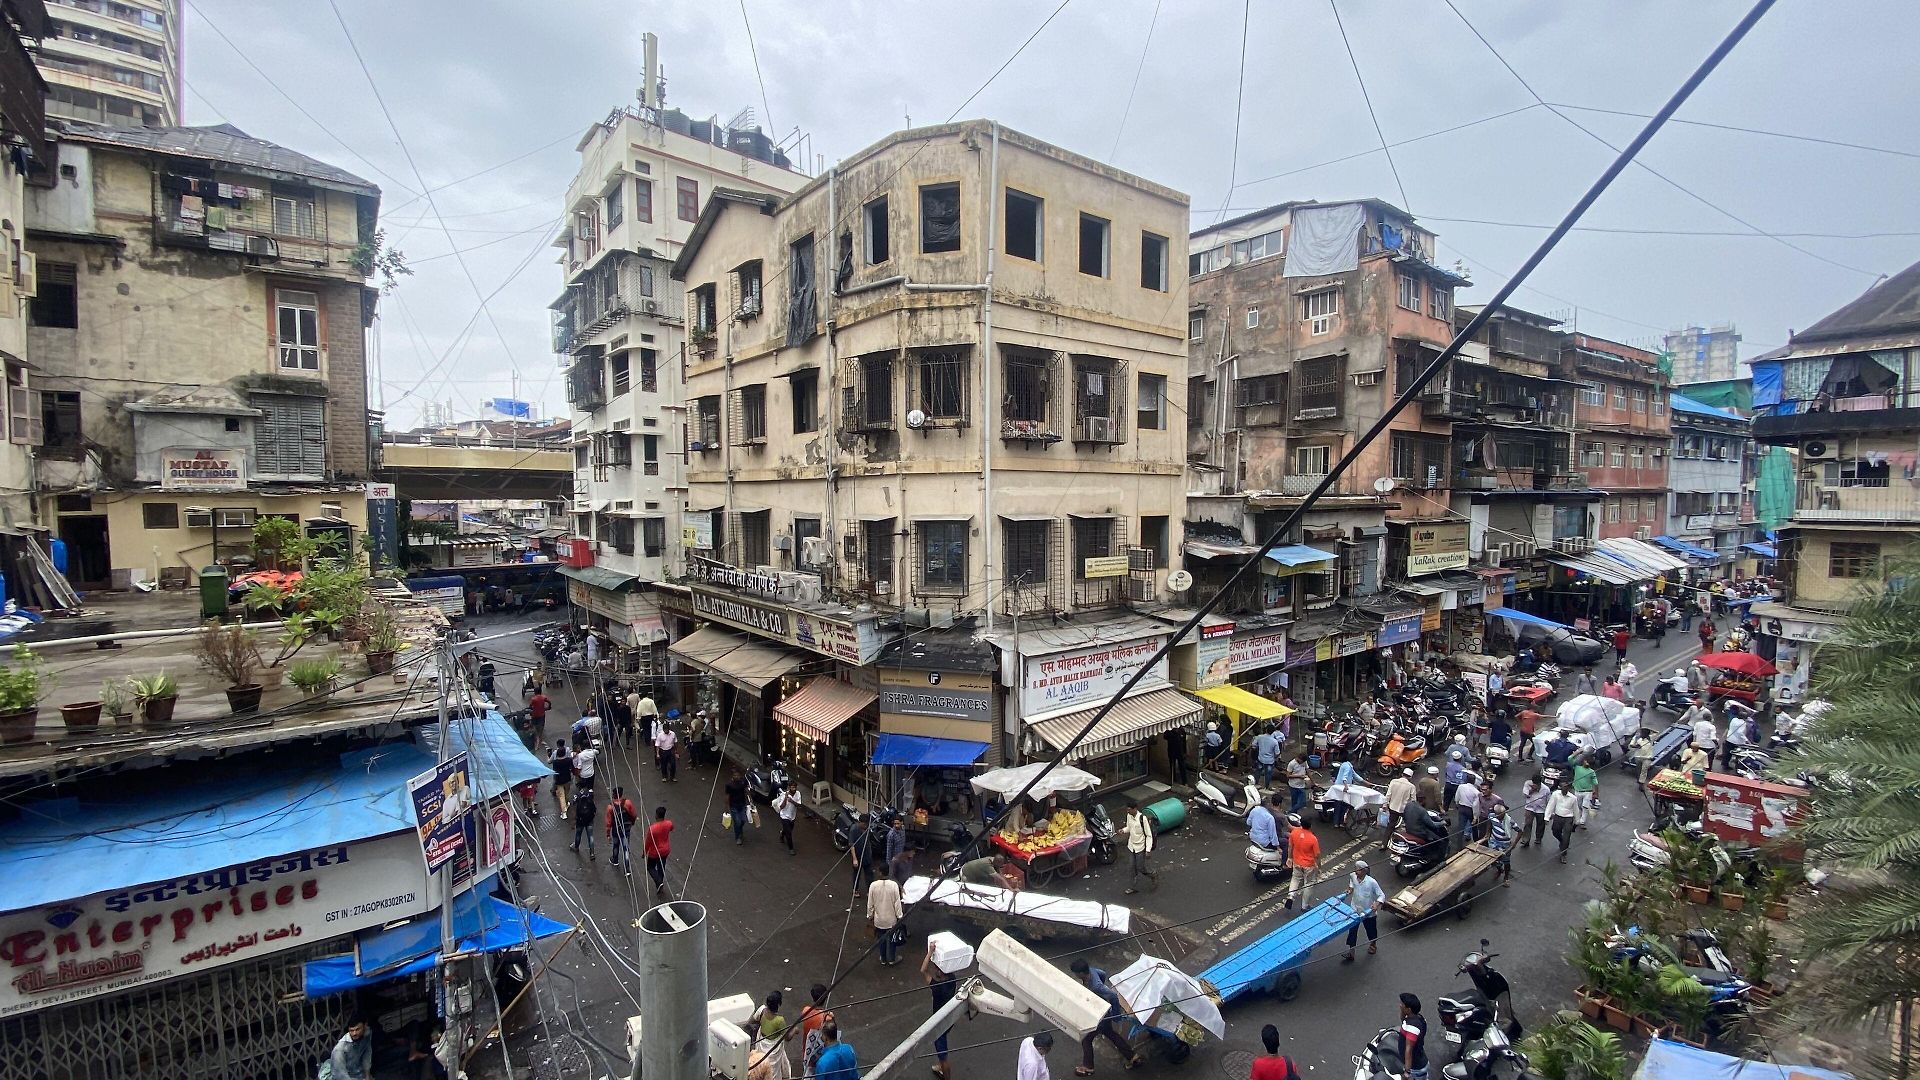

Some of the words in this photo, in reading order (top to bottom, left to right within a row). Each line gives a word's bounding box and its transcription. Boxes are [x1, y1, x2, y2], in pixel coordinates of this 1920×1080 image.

[373, 487, 389, 497] अल
[711, 597, 760, 628] ATTARWALA
[760, 610, 769, 630] &
[1111, 644, 1134, 660] मलिक
[1230, 651, 1249, 664] ROYAL
[1251, 645, 1282, 660] MELAMINE
[1045, 688, 1059, 700] AL
[1060, 680, 1090, 698] AAQIB
[883, 691, 916, 706] ISHRA
[917, 694, 989, 711] FRAGRANCES
[0, 878, 319, 968] Enterprises
[325, 911, 340, 922] GST
[341, 908, 348, 919] IN
[1, 1001, 39, 1015] SHERIFF
[42, 994, 68, 1006] DEVJI
